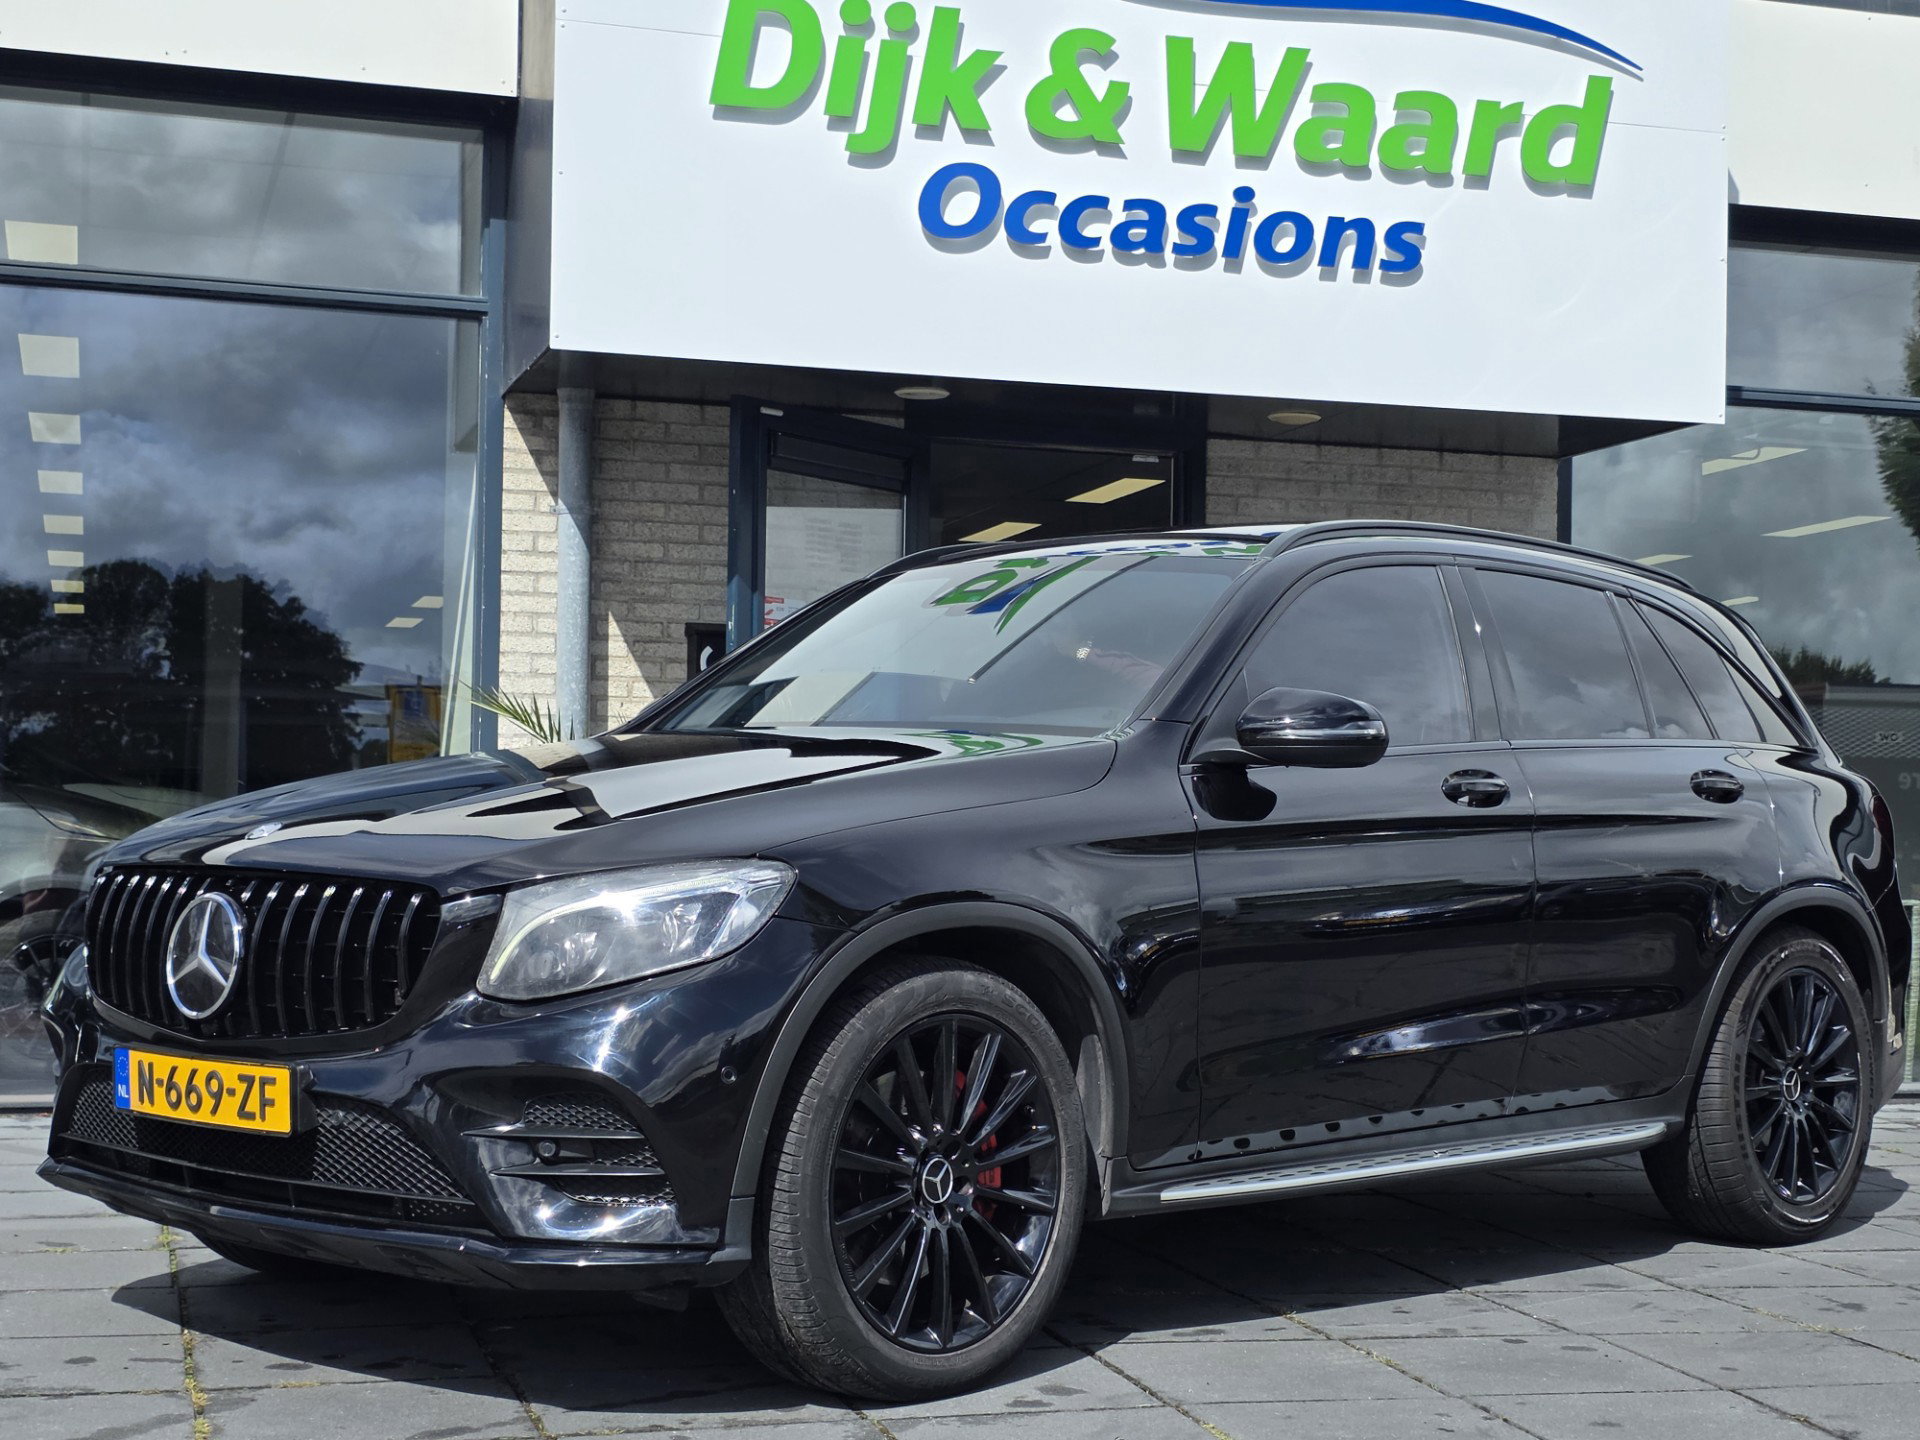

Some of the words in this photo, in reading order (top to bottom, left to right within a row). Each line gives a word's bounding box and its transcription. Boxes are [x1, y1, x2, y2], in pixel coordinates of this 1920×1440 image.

[709, 0, 1004, 154] Dijk
[1026, 28, 1130, 143] &
[1166, 36, 1612, 184] Waard
[918, 162, 1426, 273] Occasions
[118, 1083, 129, 1098] NL
[138, 1059, 277, 1122] N-669-ZF
